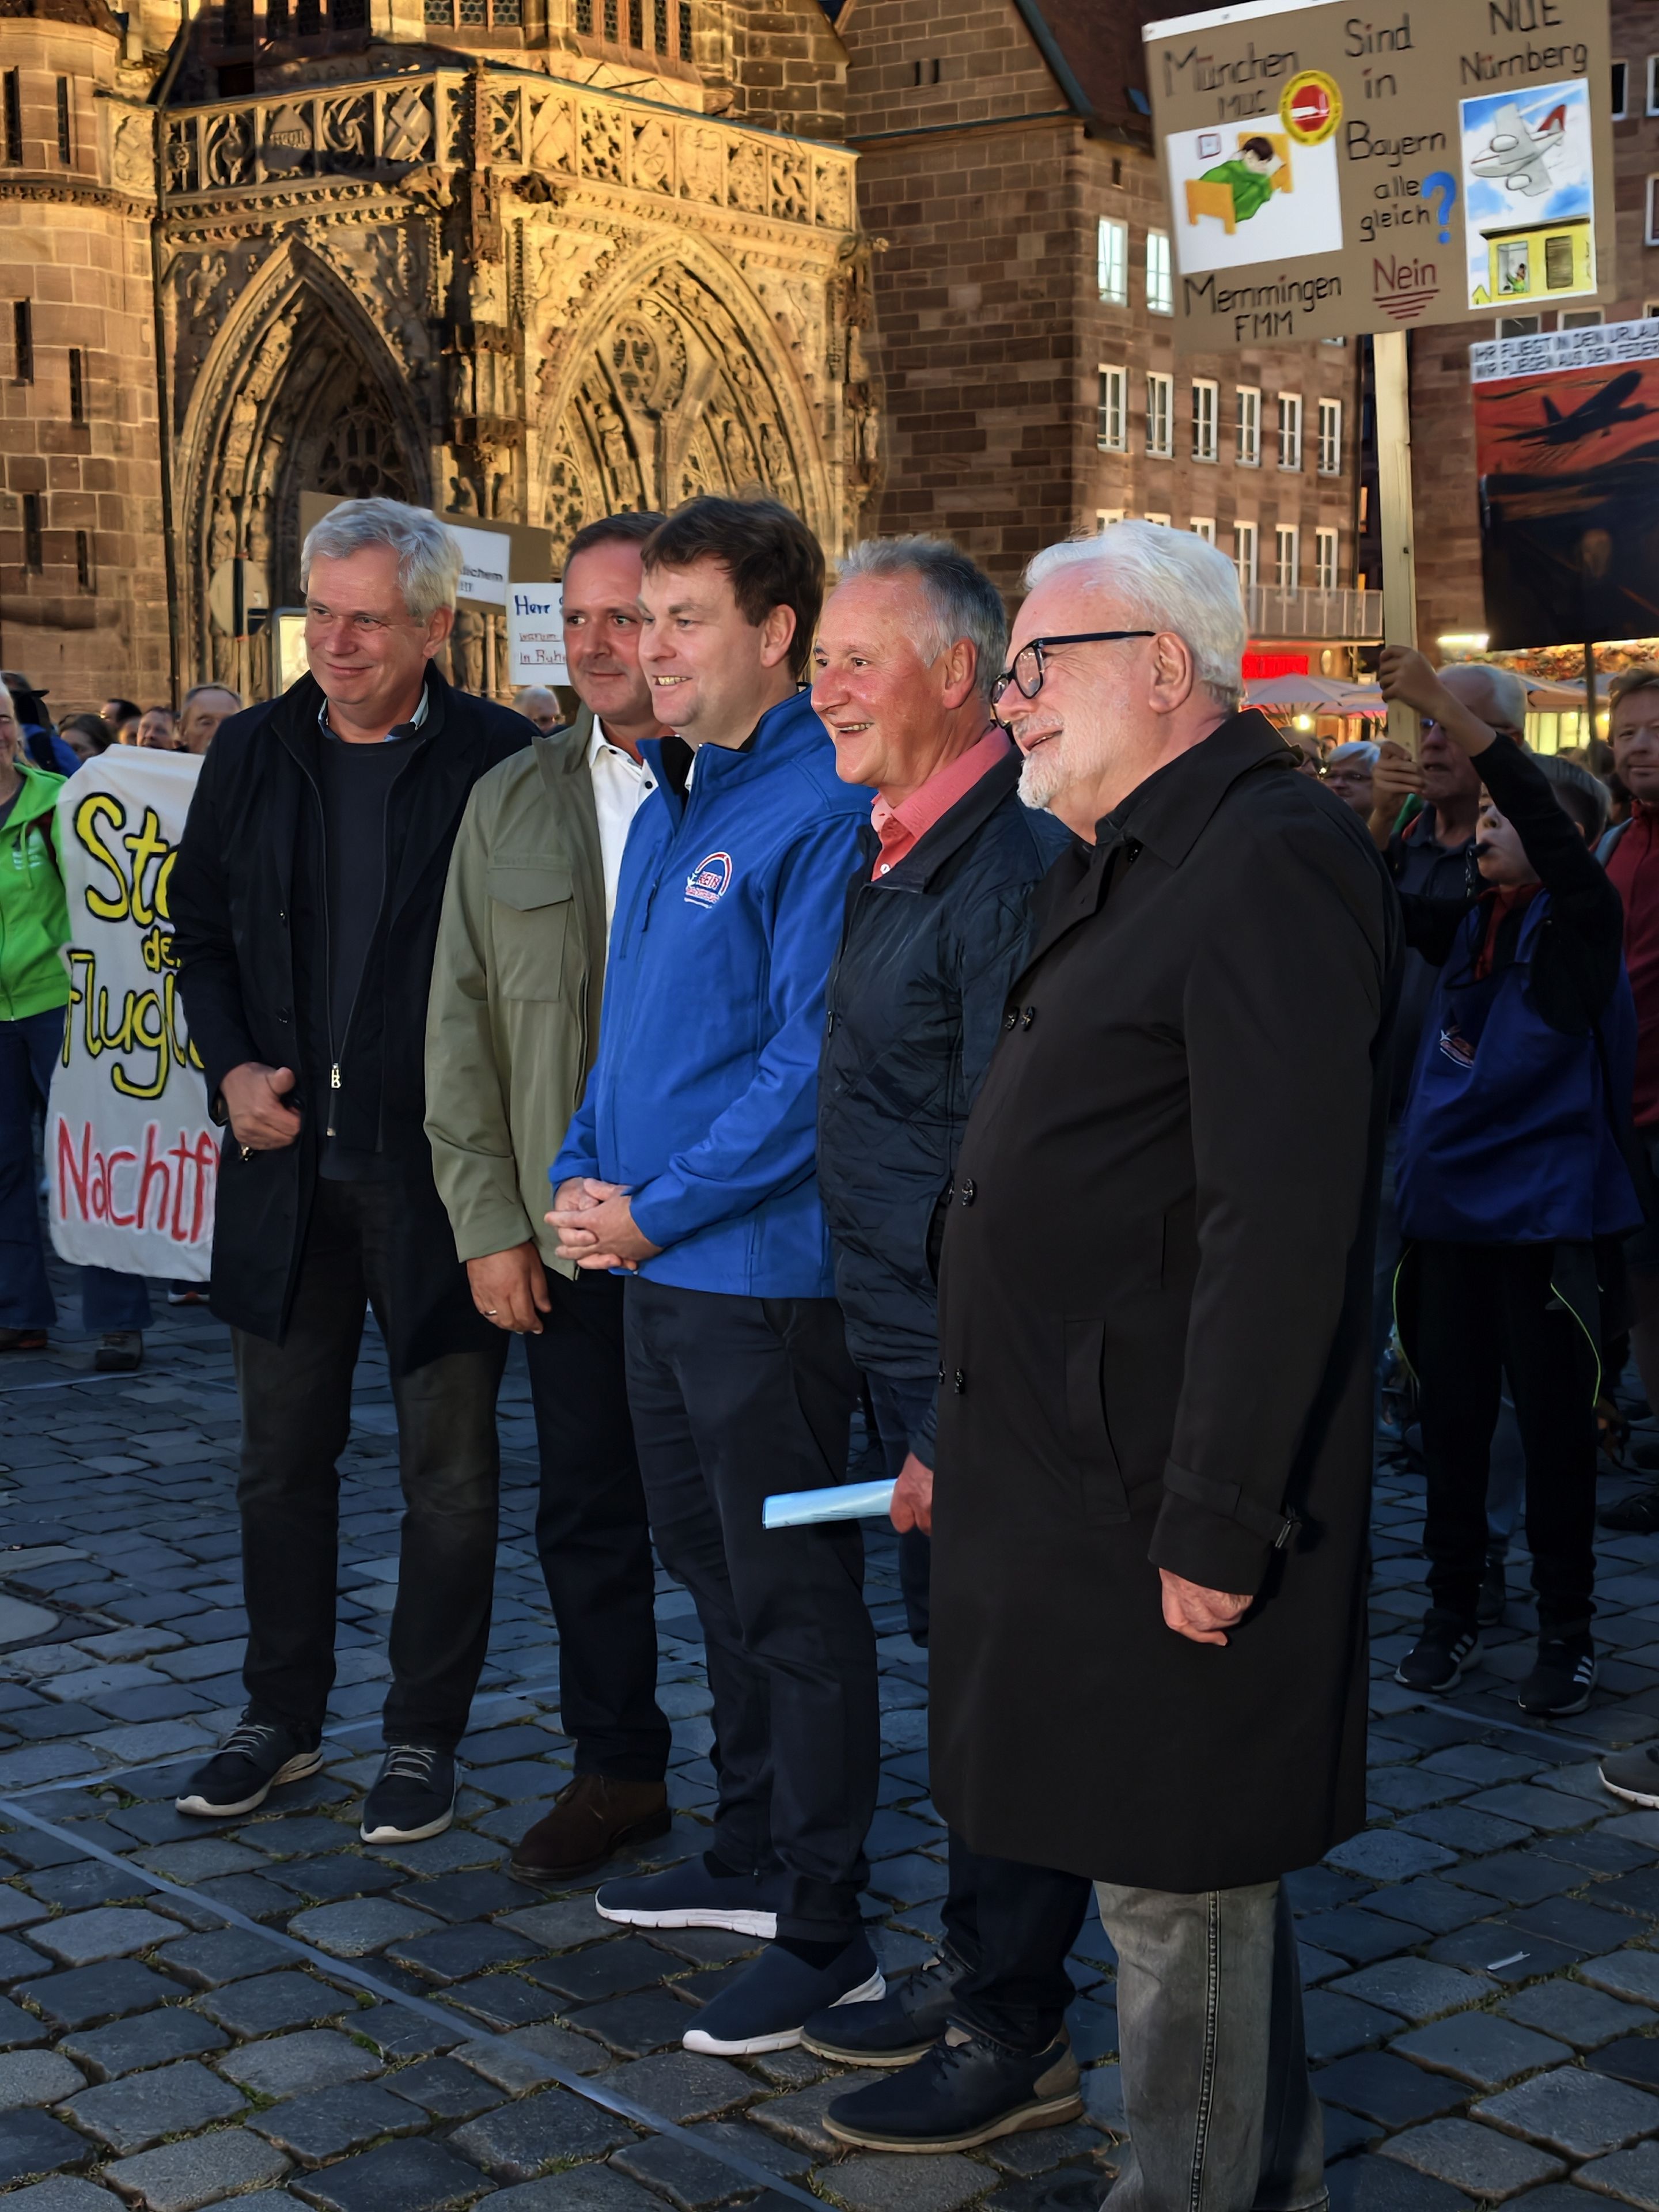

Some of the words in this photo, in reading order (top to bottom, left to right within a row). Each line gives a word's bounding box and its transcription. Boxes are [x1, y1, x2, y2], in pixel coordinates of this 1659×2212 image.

[1344, 13, 1415, 57] Sind
[1488, 0, 1562, 35] NUE
[1163, 42, 1300, 97] München
[1362, 67, 1396, 99] in
[1460, 41, 1588, 85] Nürnberg
[1217, 90, 1266, 119] MUC
[1346, 120, 1446, 168] Bayern
[1374, 176, 1419, 199] alle
[1359, 203, 1430, 242] gleich
[1373, 254, 1437, 293] Nein
[1184, 274, 1342, 316] Memmingen
[1235, 310, 1293, 342] FMM
[514, 594, 551, 616] Herr
[142, 925, 183, 973] de
[62, 949, 204, 1100] Flugl
[59, 1118, 221, 1244] Nachtf
